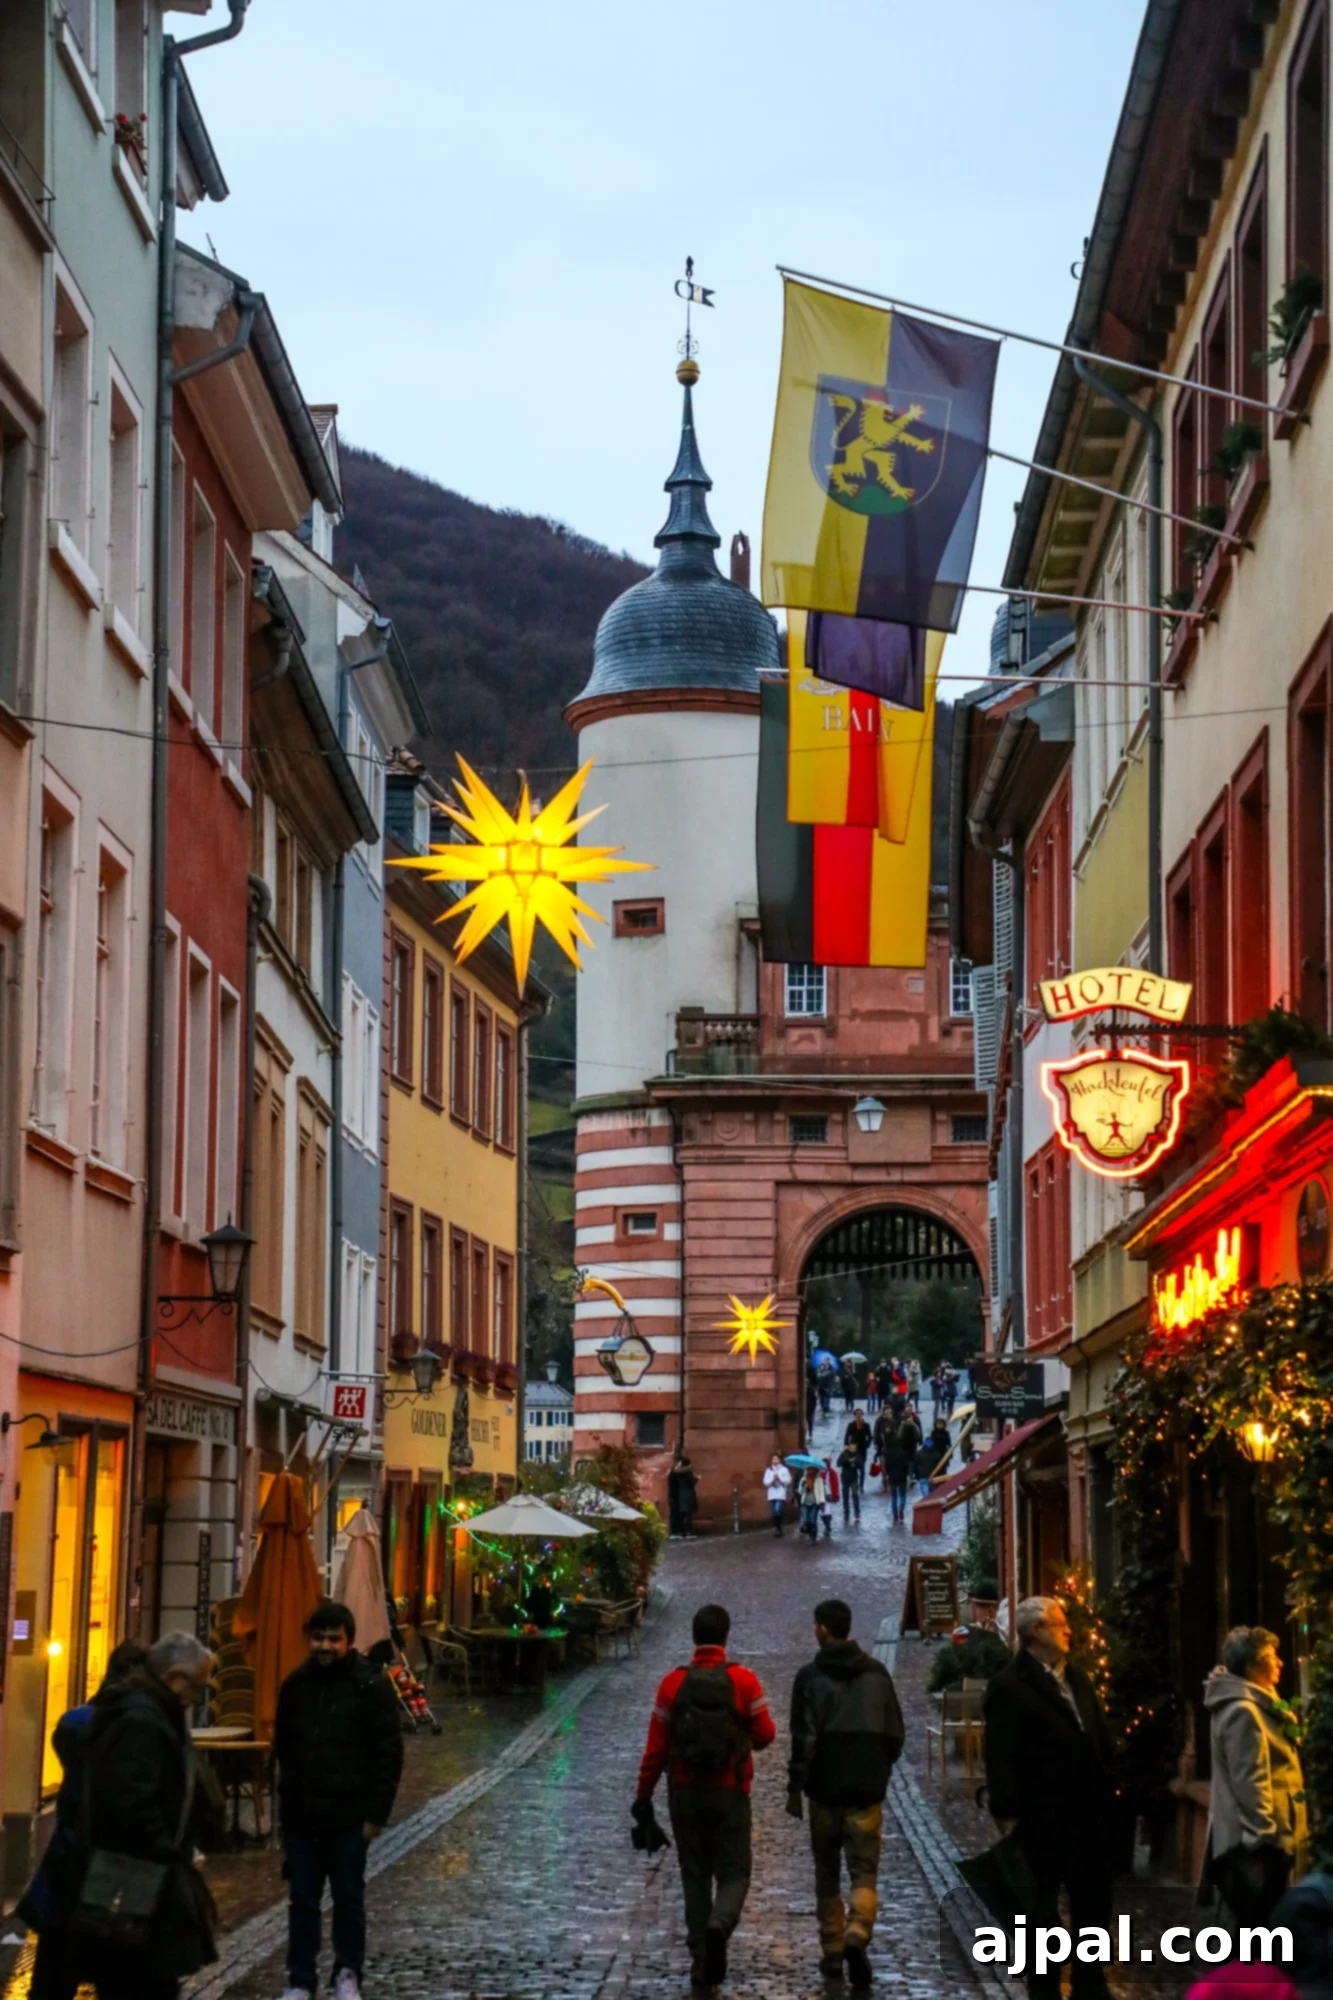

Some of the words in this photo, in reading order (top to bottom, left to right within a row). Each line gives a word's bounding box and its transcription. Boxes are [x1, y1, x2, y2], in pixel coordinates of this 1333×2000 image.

[1049, 972, 1178, 1013] HOTEL
[1070, 1067, 1162, 1103] Hackteufel
[161, 1397, 178, 1431] DEL
[411, 1407, 447, 1438] GOLDENER
